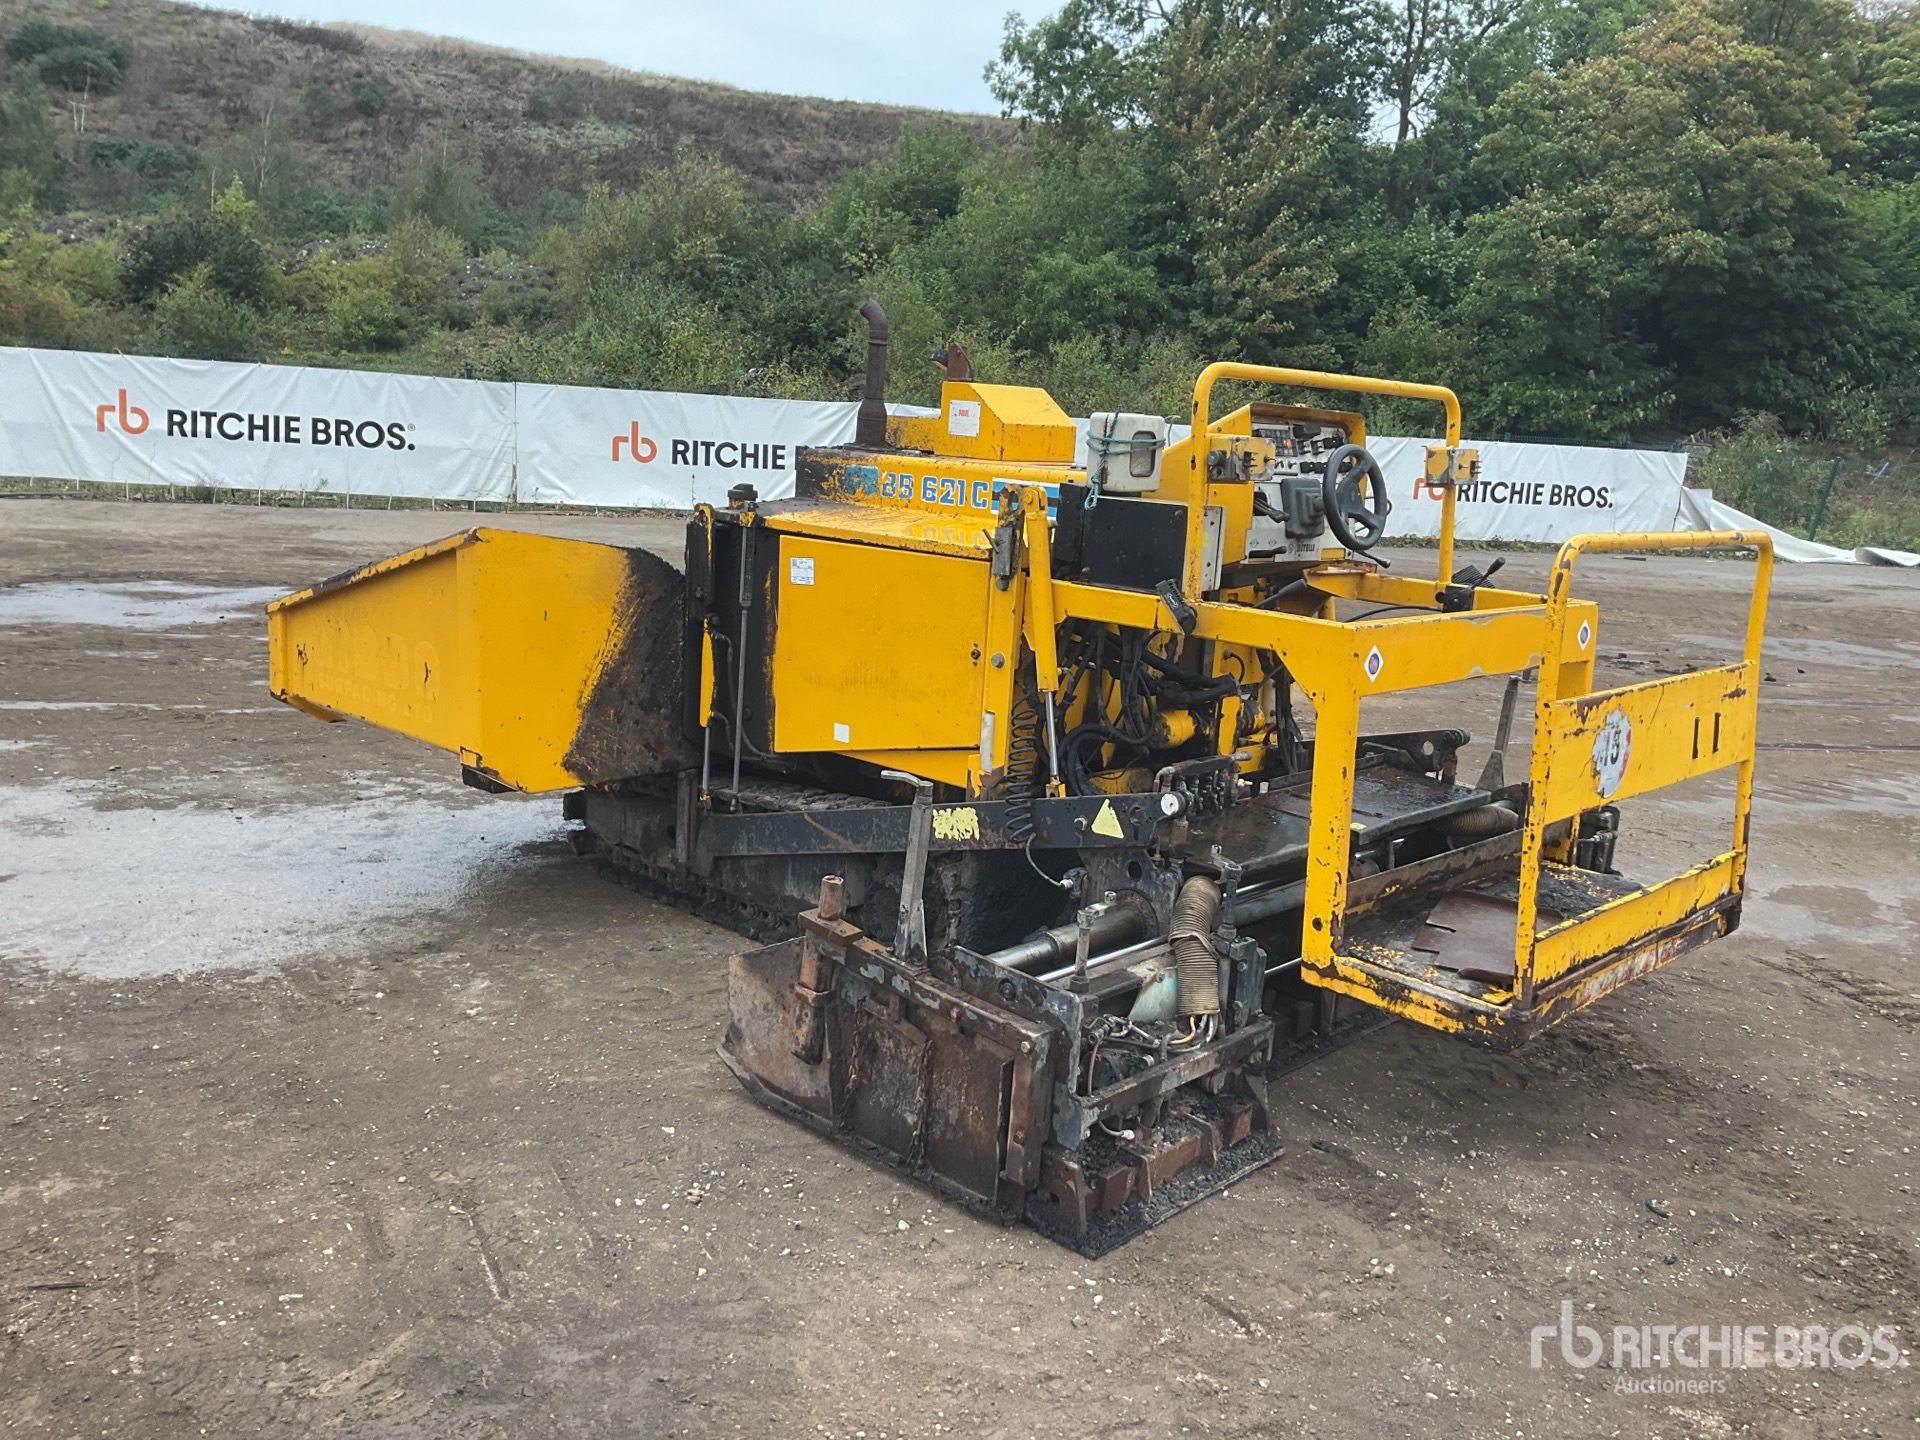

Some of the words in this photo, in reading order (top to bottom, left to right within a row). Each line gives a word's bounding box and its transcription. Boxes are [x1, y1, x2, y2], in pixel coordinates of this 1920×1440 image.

[96, 388, 149, 435] rb
[167, 409, 301, 444] RITCHIE
[311, 417, 416, 451] BROS.
[612, 421, 658, 463] rb
[671, 439, 786, 470] RITCHIE
[1457, 480, 1544, 505] RITCHIE
[1549, 484, 1613, 509] BROS.
